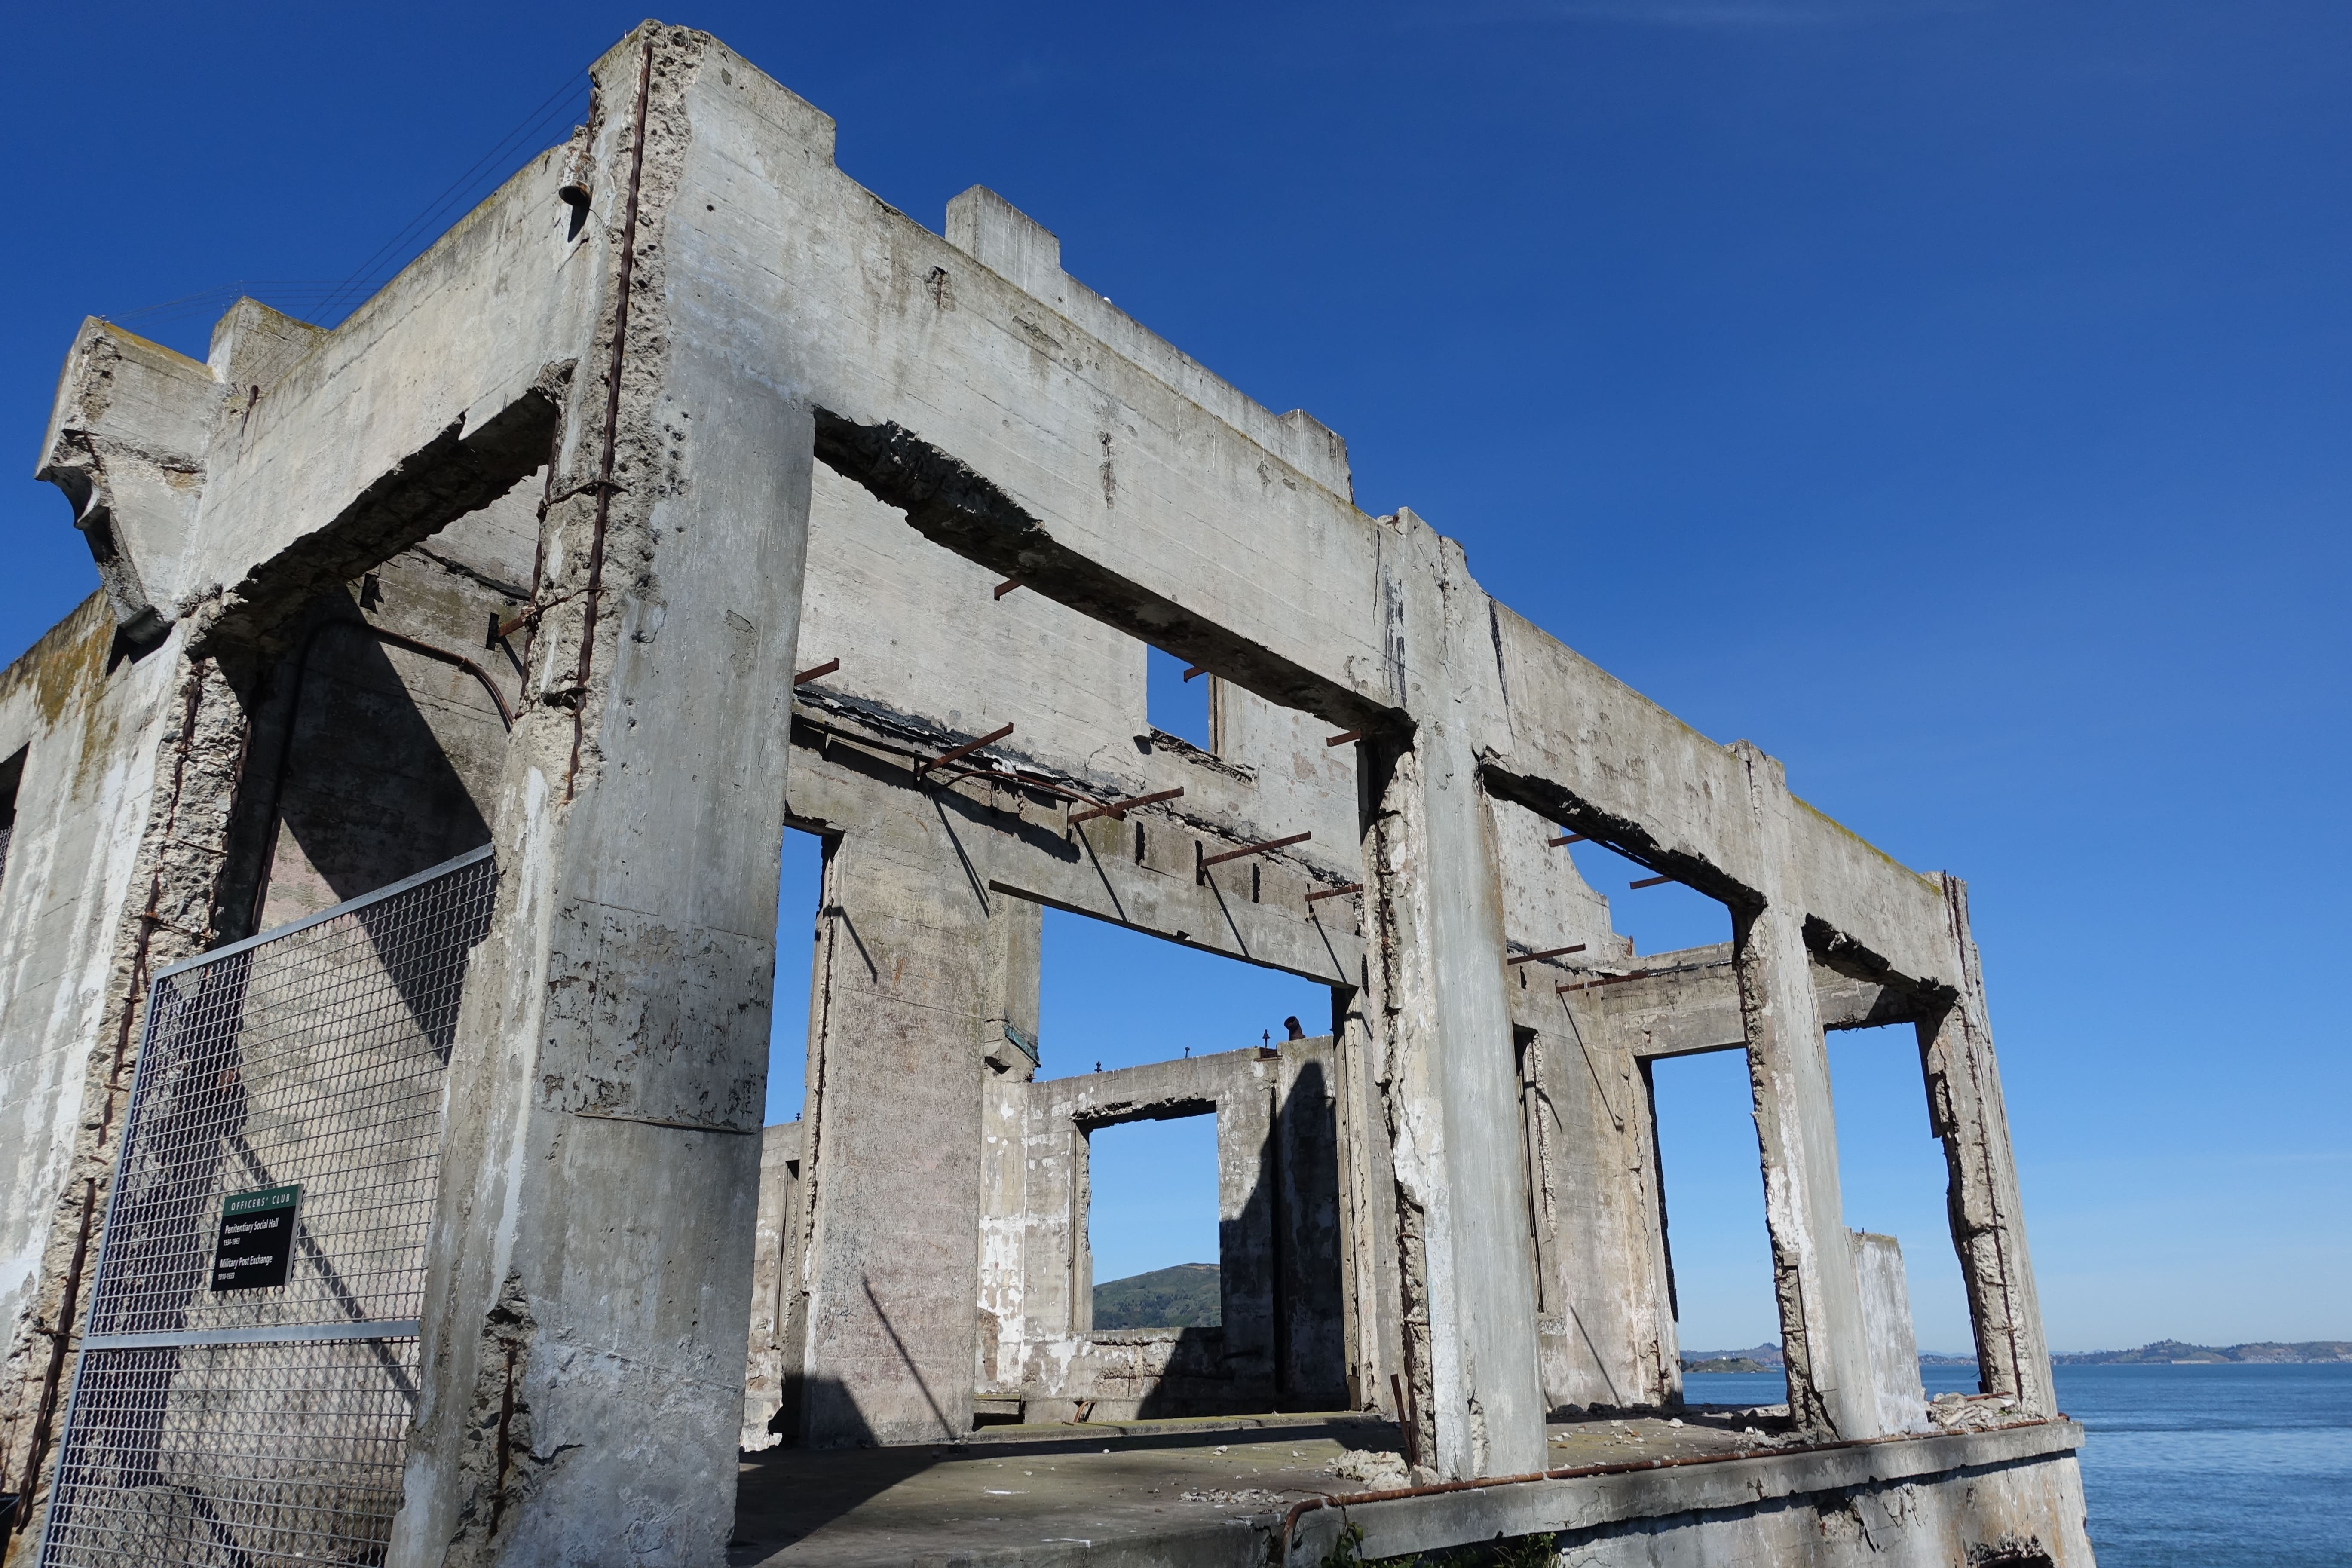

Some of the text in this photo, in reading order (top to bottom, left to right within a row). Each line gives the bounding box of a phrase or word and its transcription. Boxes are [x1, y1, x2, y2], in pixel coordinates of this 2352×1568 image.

[231, 1193, 290, 1211] OFFICERS' CLUB
[225, 1217, 279, 1234] Penitentiary Social Hall
[219, 1254, 273, 1269] Military Post Exchange
